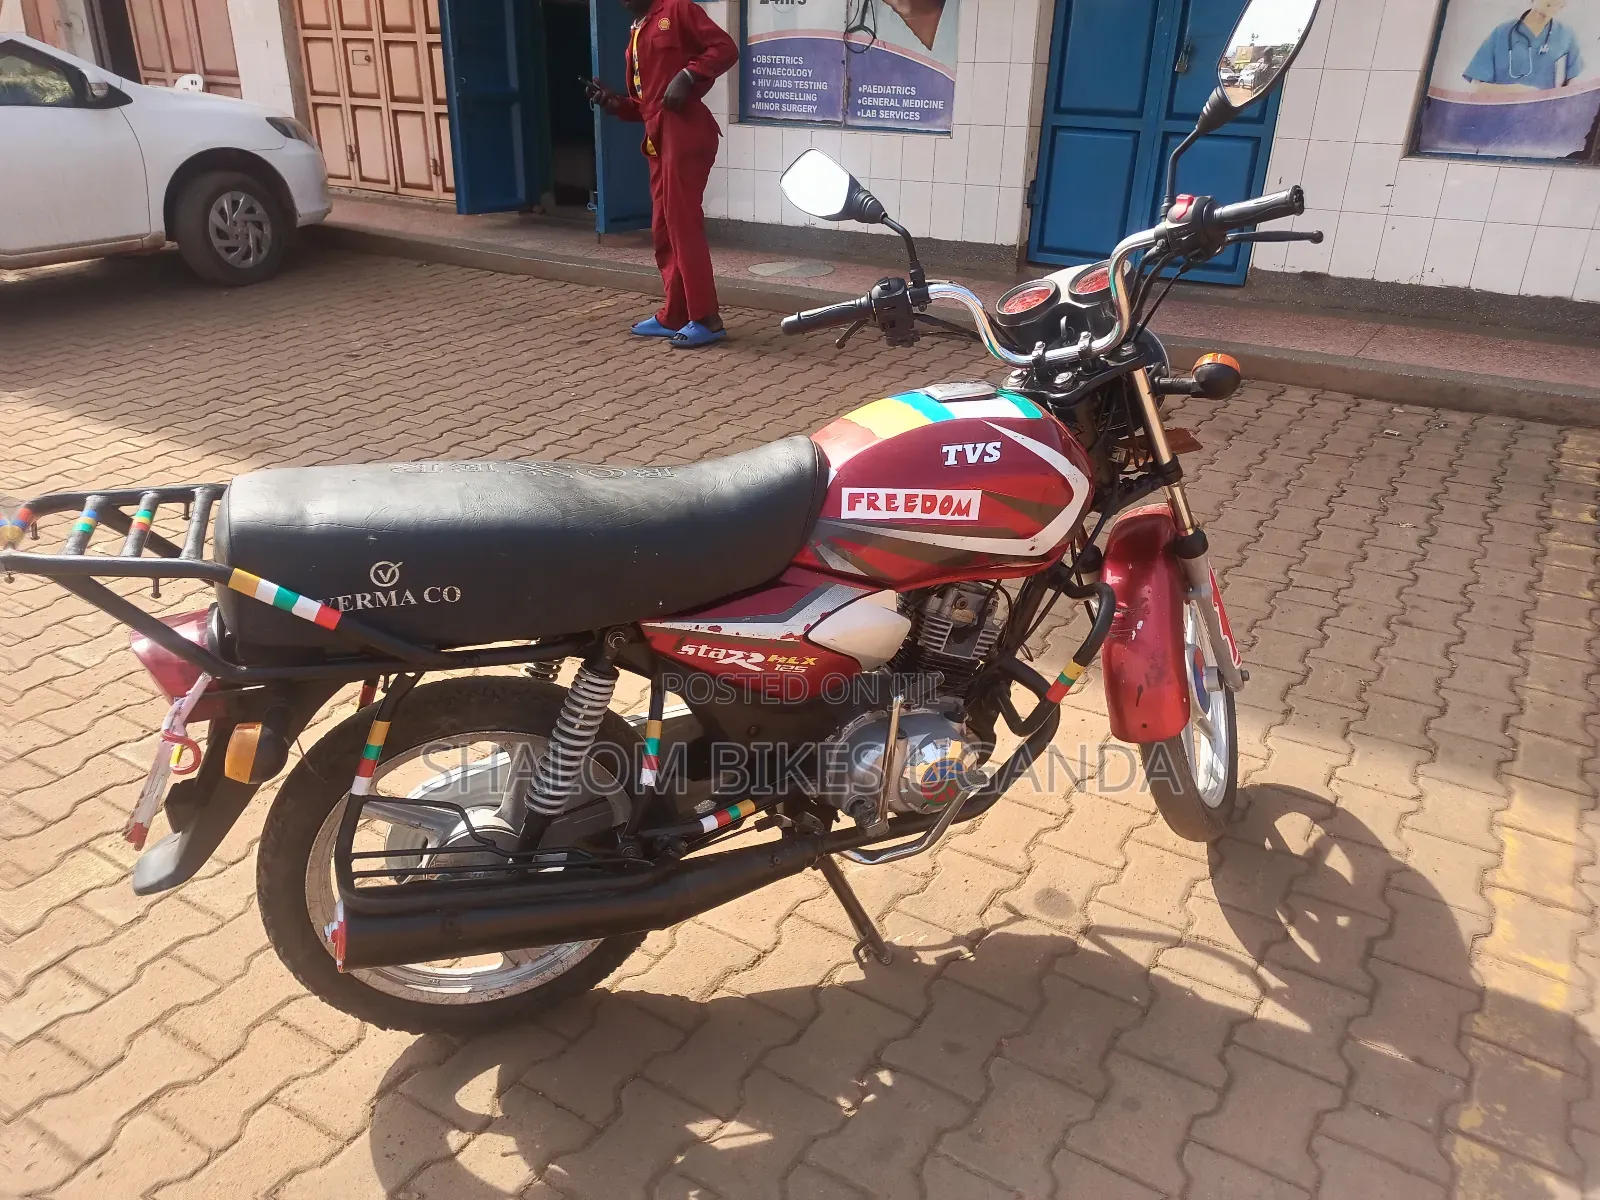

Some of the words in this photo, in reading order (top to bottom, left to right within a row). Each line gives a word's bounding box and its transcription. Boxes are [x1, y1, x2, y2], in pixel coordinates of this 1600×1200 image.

[756, 55, 804, 65] OBSTETRICS
[756, 67, 813, 77] GYNAECOLOGY
[757, 79, 771, 87] HIV
[794, 81, 828, 90] TESTING
[862, 85, 916, 95] PAEDIATRICS
[756, 91, 762, 99] &
[763, 91, 818, 101] COUNSELLING
[755, 102, 780, 111] MINOR
[781, 104, 818, 113] SURGERY
[861, 97, 901, 107] GENERAL
[902, 99, 945, 109] MEDICINE
[861, 109, 877, 118] LAB
[878, 110, 921, 121] SERVICES
[941, 441, 1002, 466] TVS
[847, 492, 973, 517] FREEDOM
[423, 585, 462, 603] CO
[773, 664, 809, 673] 125
